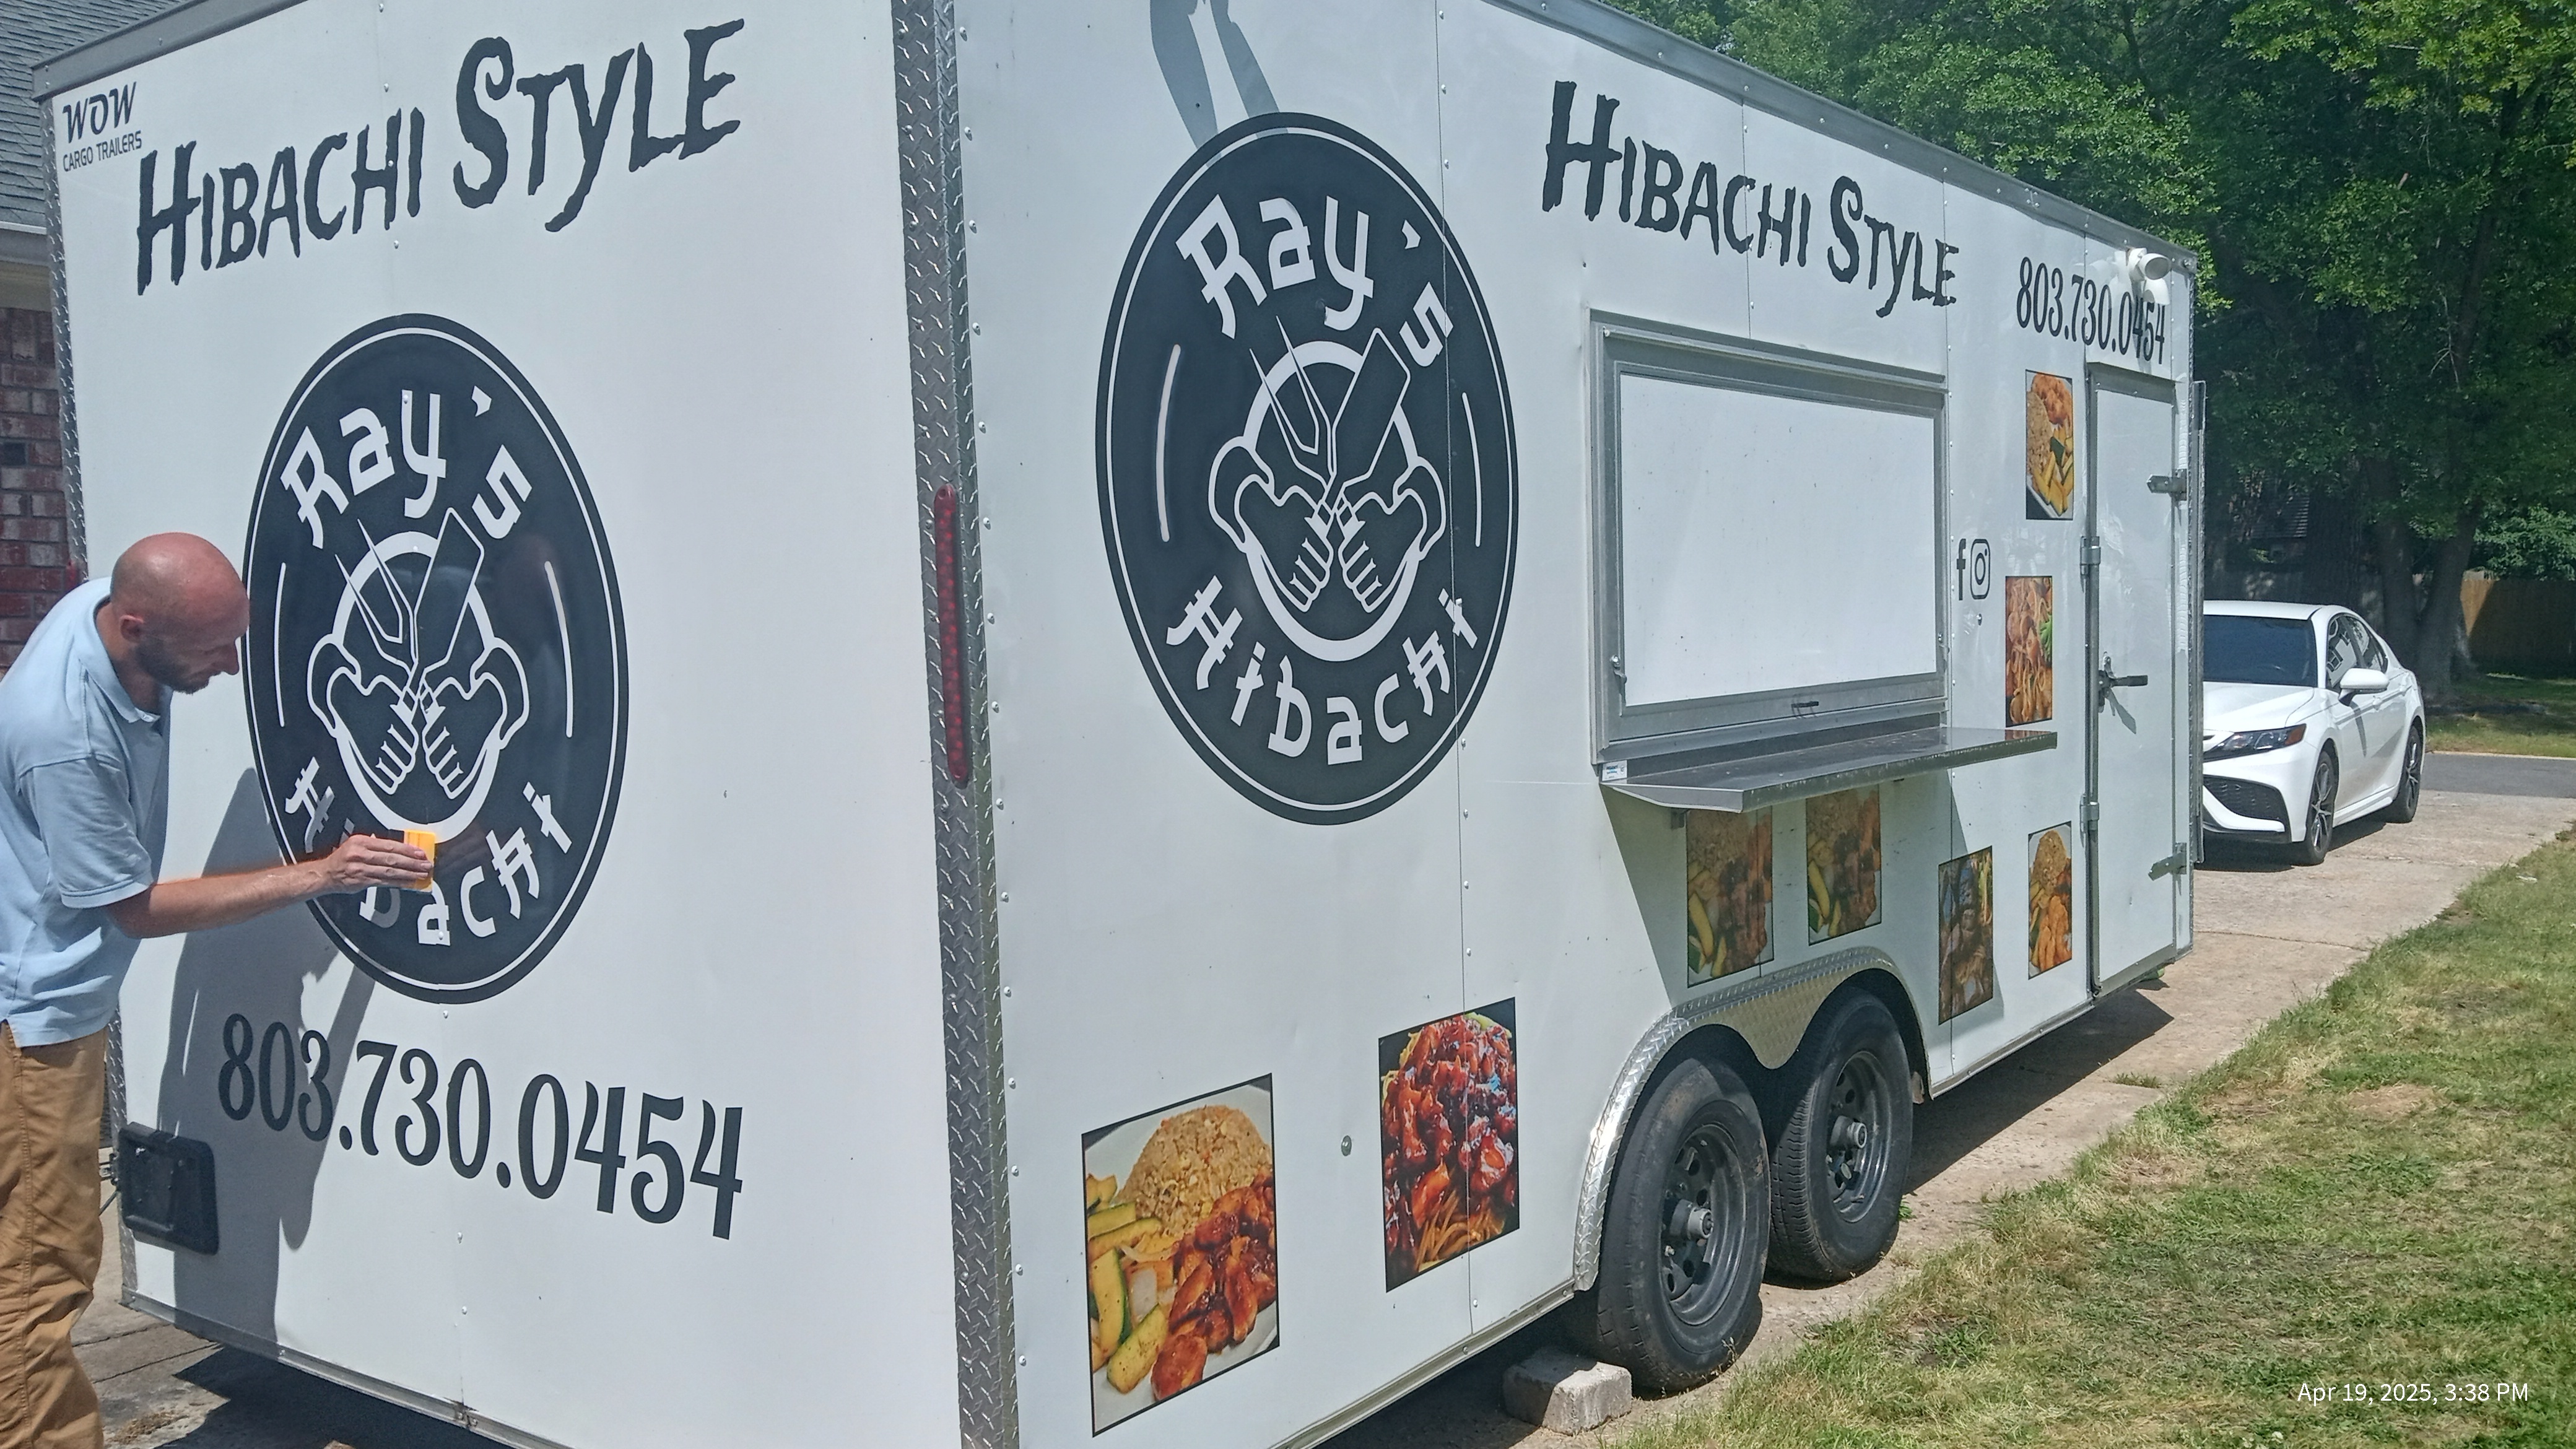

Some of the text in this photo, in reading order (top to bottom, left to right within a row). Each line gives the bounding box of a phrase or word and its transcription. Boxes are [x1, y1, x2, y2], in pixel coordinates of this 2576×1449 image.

[63, 81, 136, 144] WOW
[63, 130, 142, 172] CARGO TRAILERS
[137, 19, 744, 295] HIBACHI STYLE
[1543, 80, 1959, 318] HIBACHI STYLE
[1175, 194, 1453, 367] Ray's
[2016, 256, 2165, 365] 803.730.0454
[281, 385, 533, 549] Ray's
[1166, 575, 1477, 765] Hibachi
[218, 1013, 742, 1240] 803.730.0454
